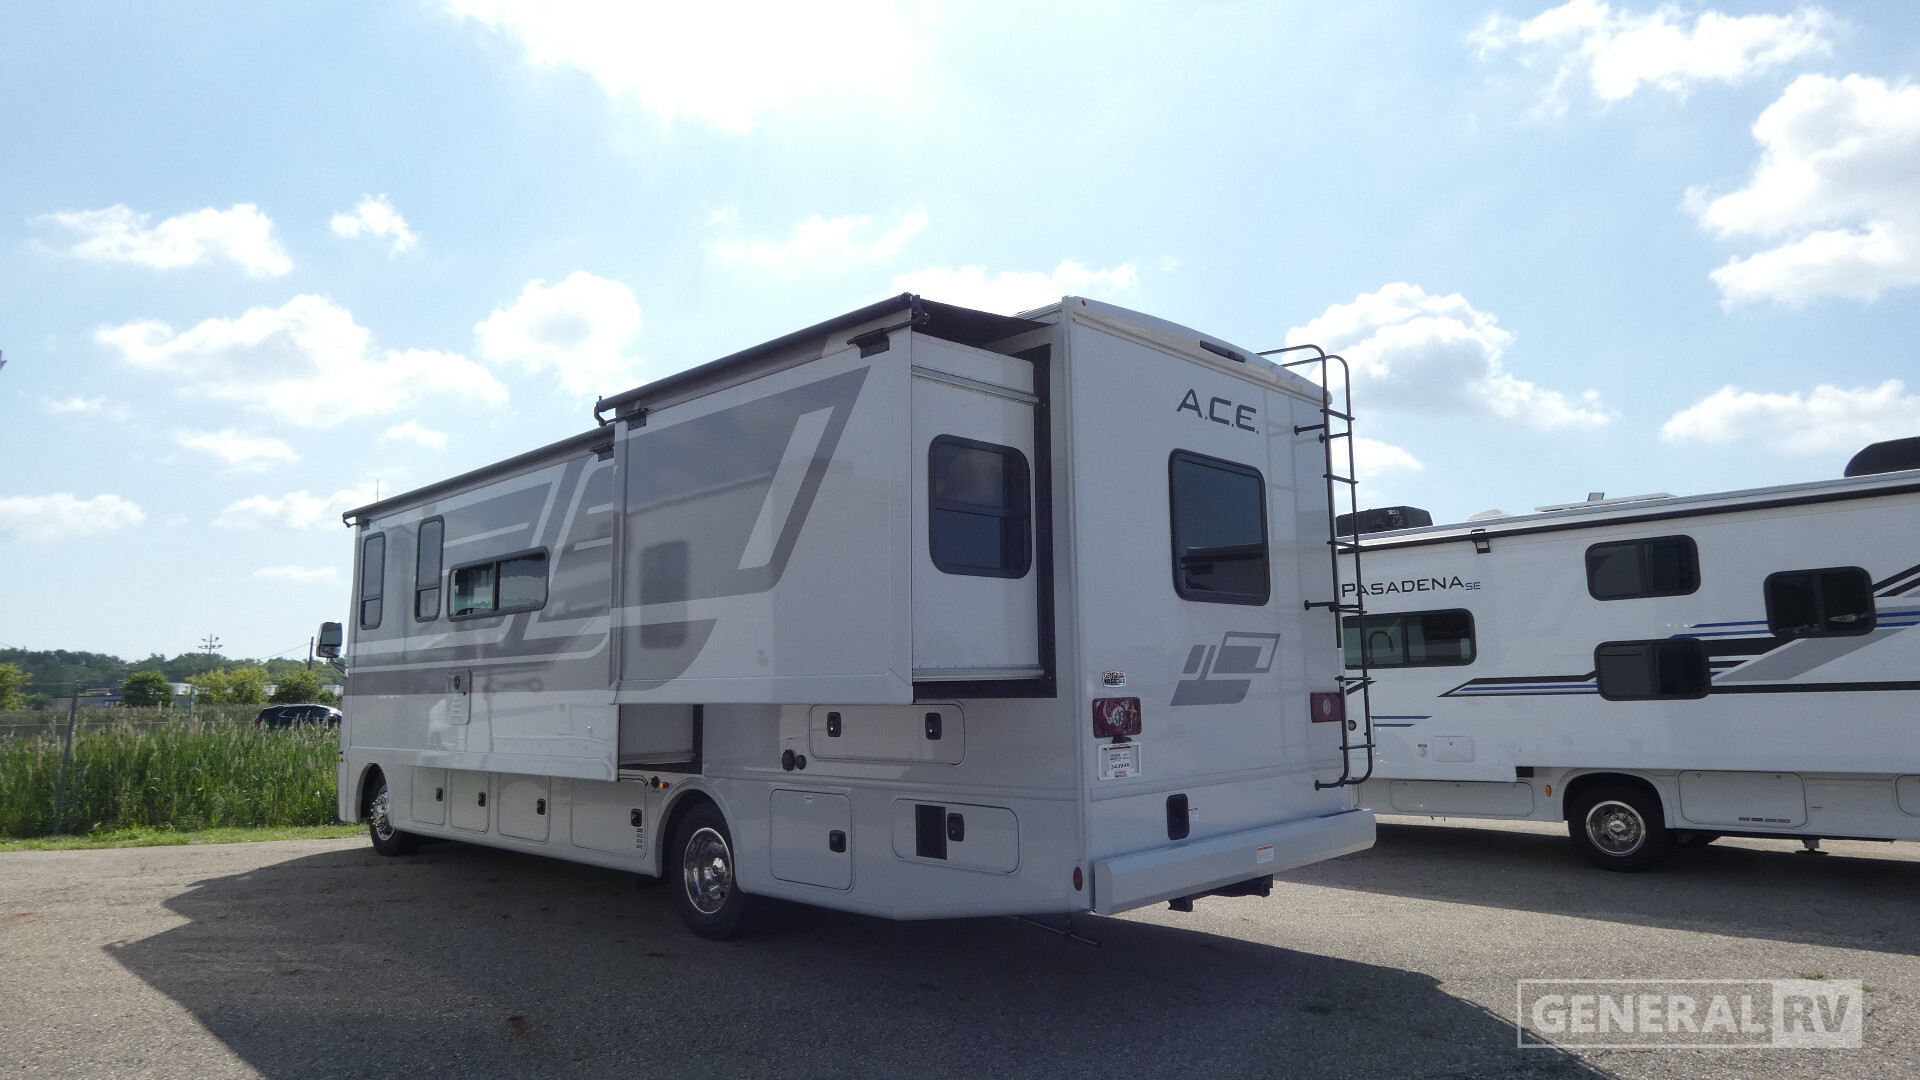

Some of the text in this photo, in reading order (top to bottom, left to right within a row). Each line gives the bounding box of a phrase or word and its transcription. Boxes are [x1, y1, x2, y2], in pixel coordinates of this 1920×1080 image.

[1176, 388, 1259, 434] A.C.E.
[1341, 576, 1481, 598] PASADENA SE
